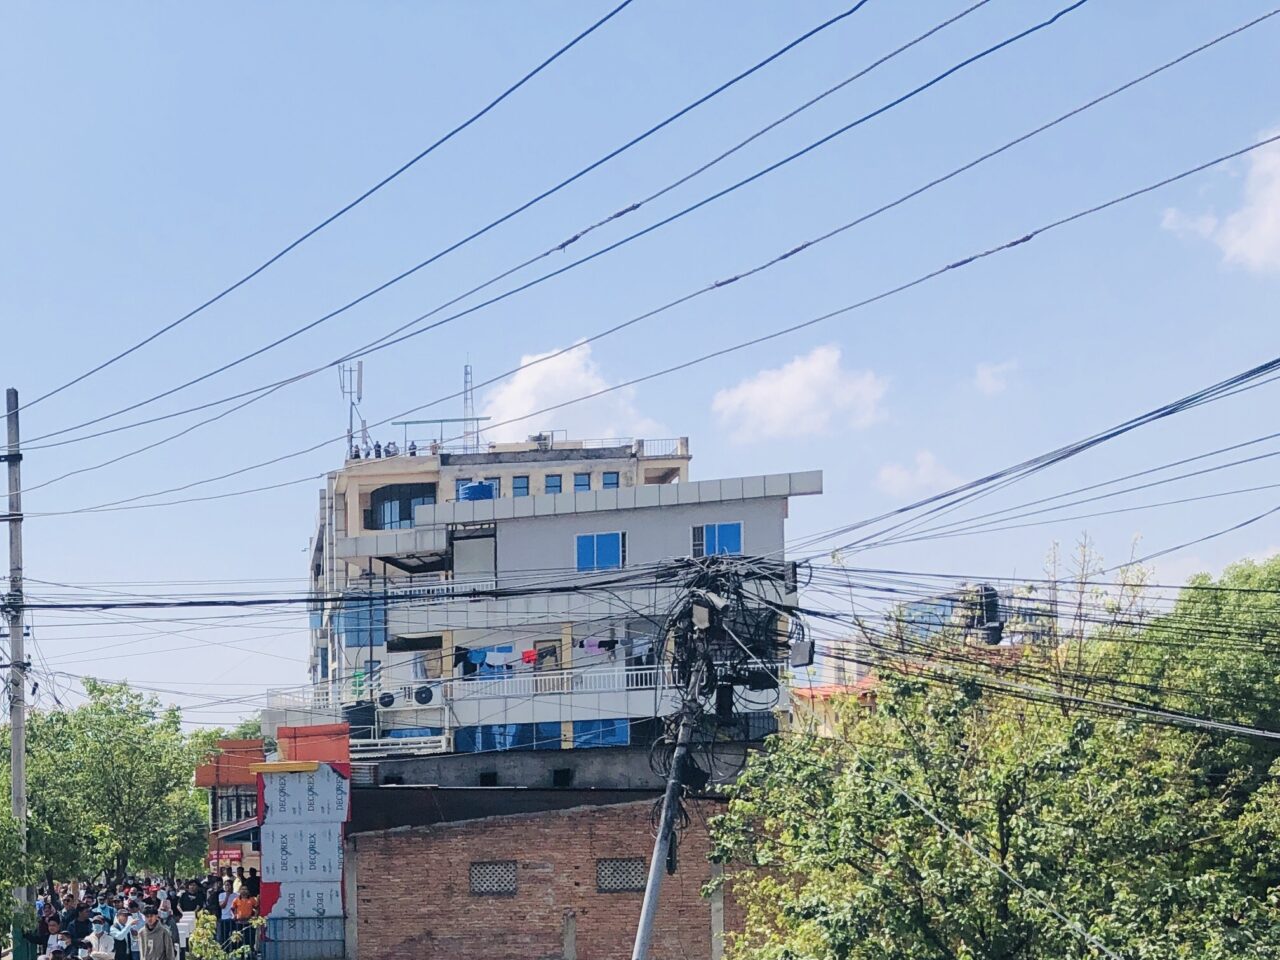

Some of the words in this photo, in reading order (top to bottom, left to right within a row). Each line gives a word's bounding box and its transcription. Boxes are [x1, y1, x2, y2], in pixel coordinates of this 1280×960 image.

[279, 775, 291, 812] DECOREX
[281, 834, 292, 871] DECOREX
[309, 833, 320, 871] DECOREX
